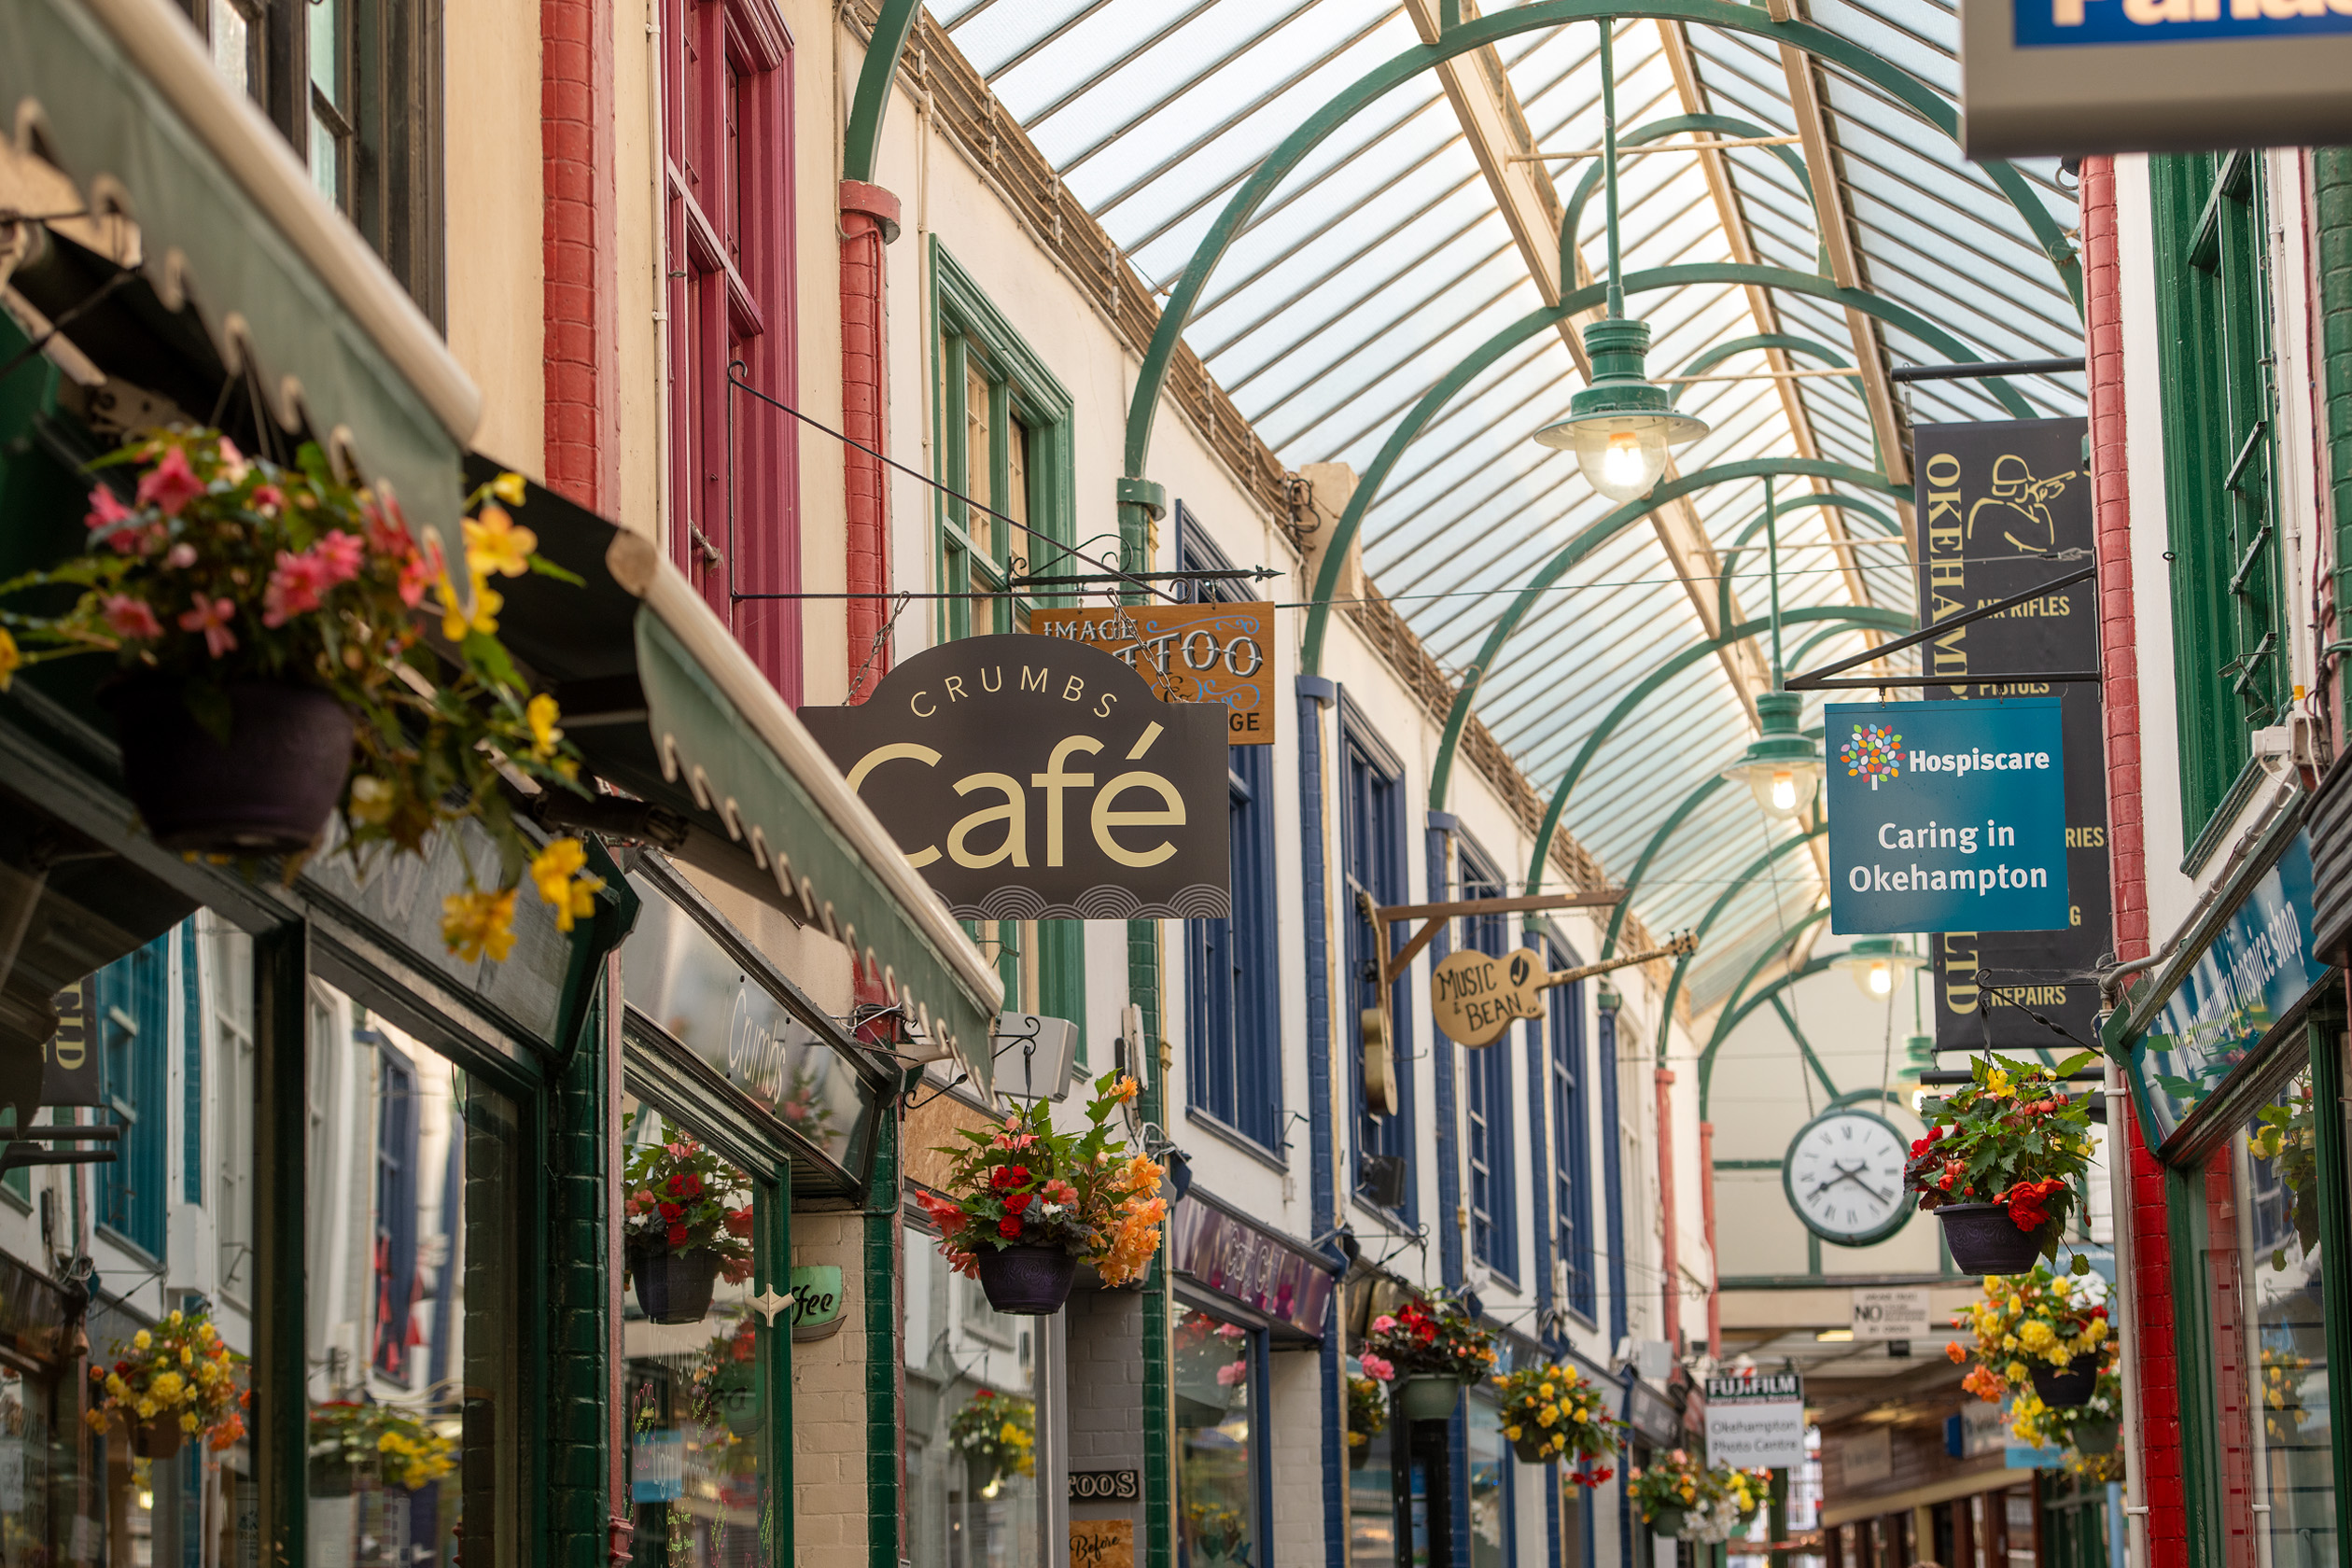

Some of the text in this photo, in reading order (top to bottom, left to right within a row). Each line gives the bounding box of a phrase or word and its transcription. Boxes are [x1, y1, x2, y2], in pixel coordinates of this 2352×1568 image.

[2010, 595, 2070, 618] RIFLES
[1043, 618, 1140, 642] IMAGE
[910, 665, 1117, 719] CRUMBS
[1910, 747, 2050, 777] Hospiscare
[845, 721, 1186, 869] Café
[1878, 819, 2015, 854] Caring in
[1849, 863, 2048, 897] Okehampton
[1436, 962, 1497, 1001] MUSIC
[1944, 931, 1980, 1015] LTD
[2189, 965, 2244, 1059] community
[2227, 925, 2275, 1009] hospice
[2268, 900, 2304, 969] shop
[1465, 992, 1523, 1032] BEAN
[1991, 986, 2067, 1007] REPAIRS
[728, 987, 787, 1105] Crumbs
[1854, 1305, 1883, 1323] NO
[1711, 1419, 1798, 1435] Okehampton
[1712, 1438, 1799, 1453] Photo Centre
[1069, 1533, 1121, 1561] Before
